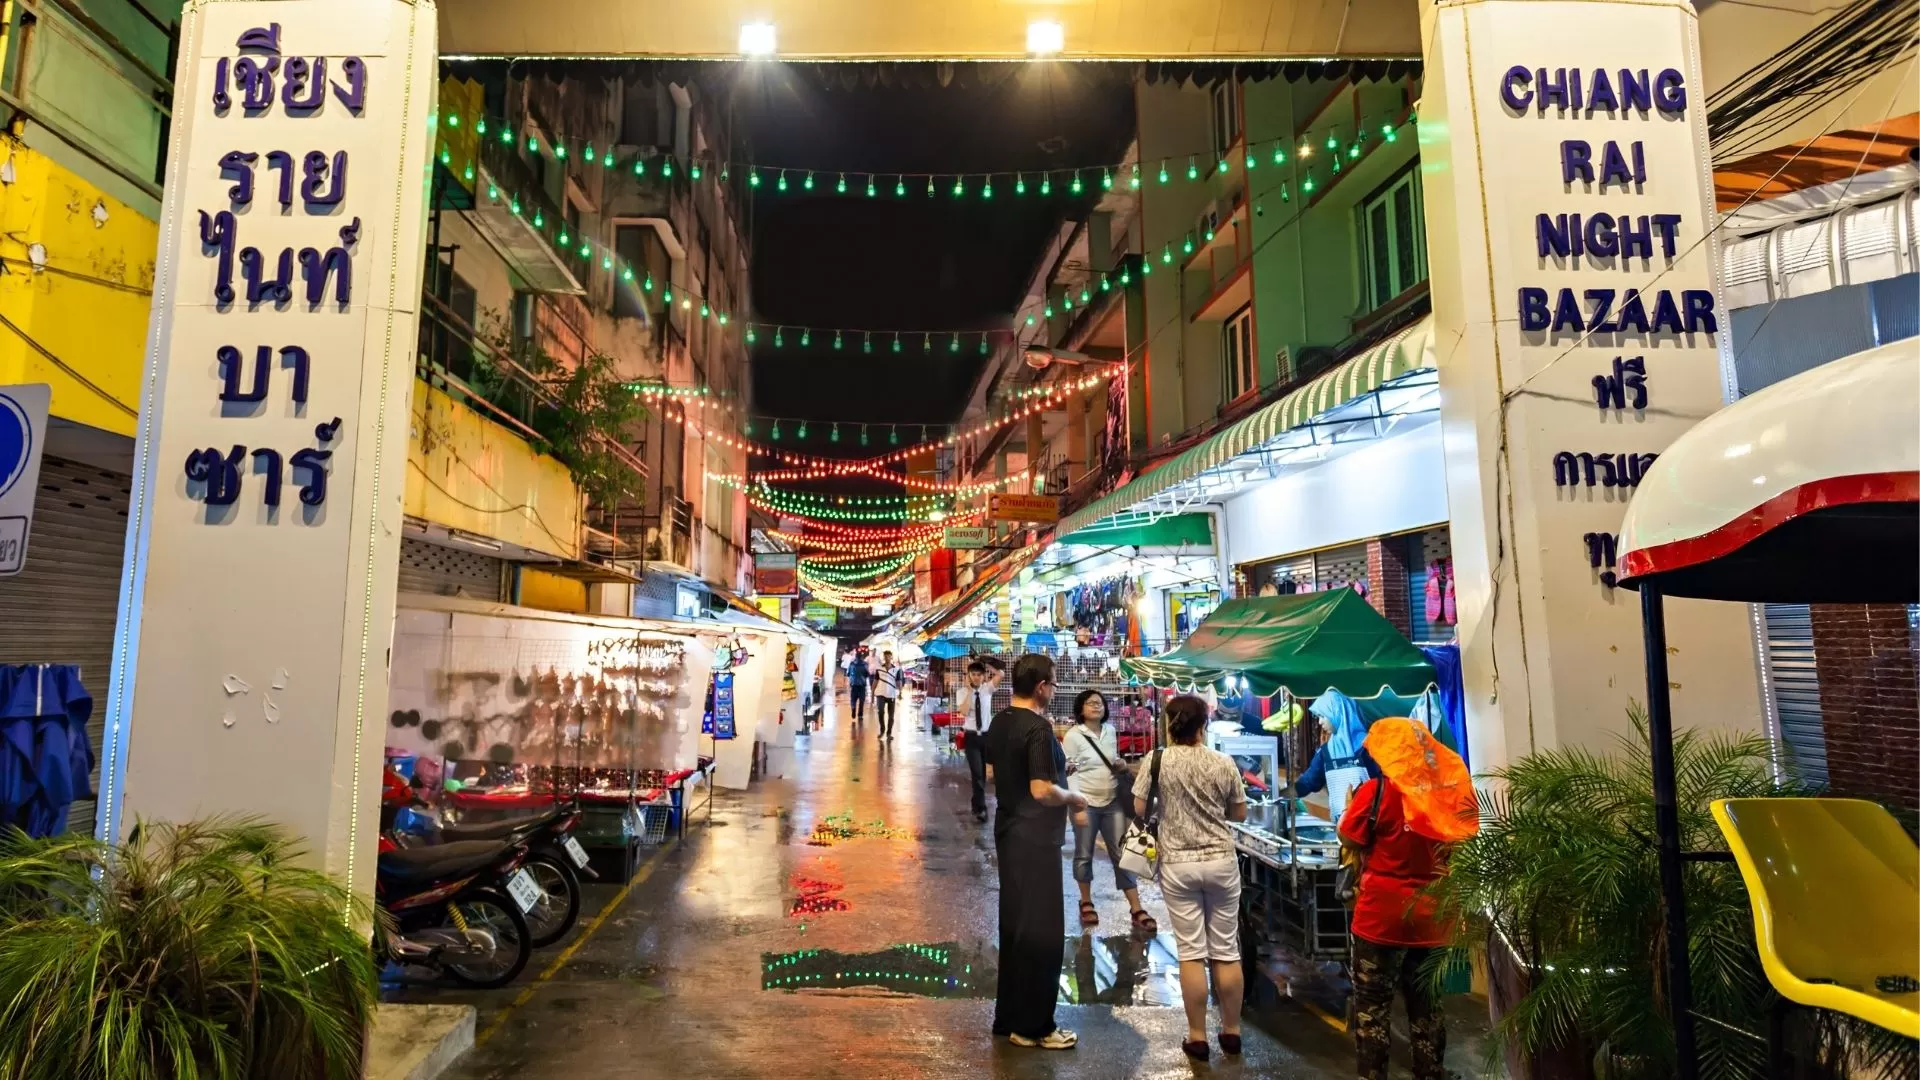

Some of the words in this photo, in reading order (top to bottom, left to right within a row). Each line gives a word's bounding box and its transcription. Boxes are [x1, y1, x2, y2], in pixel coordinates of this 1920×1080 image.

[213, 22, 367, 109] เชียง
[1501, 65, 1686, 113] CHIANG
[218, 150, 348, 203] ราย
[1560, 139, 1647, 185] RAI
[197, 209, 360, 302] ไนท์
[1535, 211, 1682, 259] NIGHT
[1517, 286, 1718, 333] BAZAAR
[217, 345, 310, 402] บา
[1592, 355, 1648, 410] ฟรี
[185, 416, 342, 505] ซาร์
